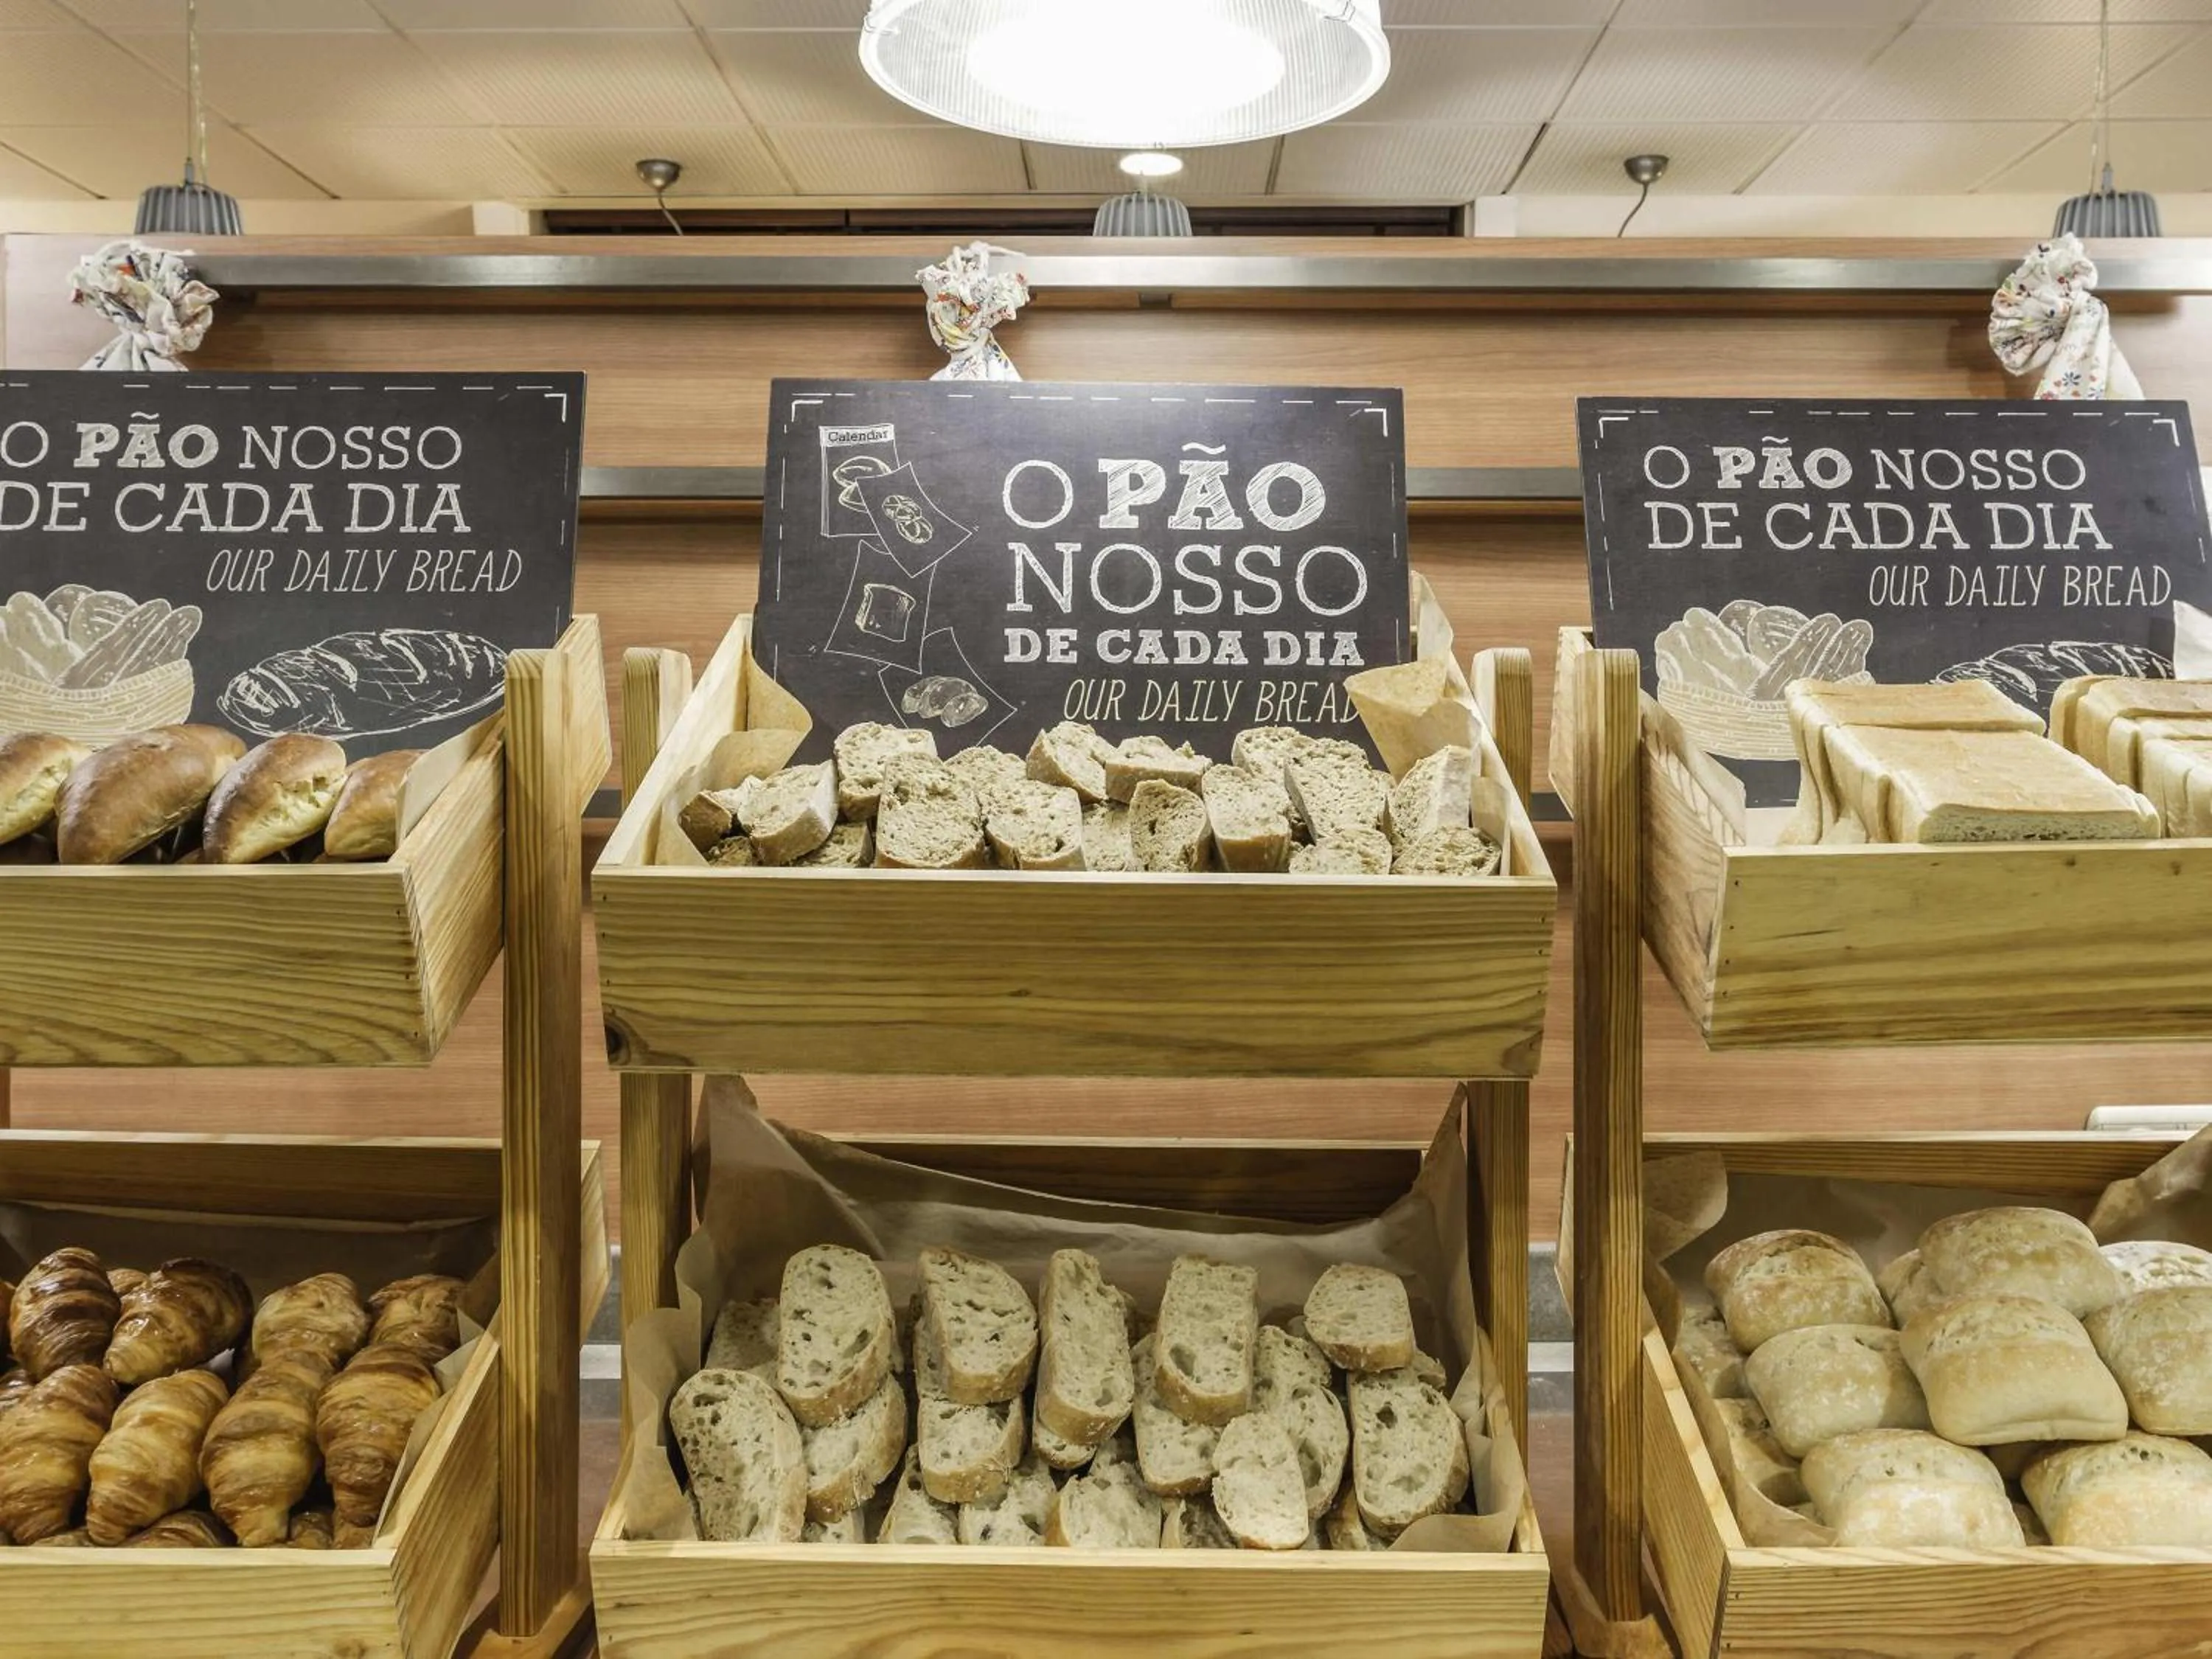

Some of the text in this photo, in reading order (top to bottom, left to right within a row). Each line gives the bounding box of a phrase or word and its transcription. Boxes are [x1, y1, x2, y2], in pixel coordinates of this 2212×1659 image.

[1, 411, 462, 470] O PÃO NOSSO
[827, 430, 888, 442] Calendar
[1001, 442, 1326, 532] O PÃO
[1644, 436, 2087, 490] O PÃO NOSSO
[0, 480, 472, 533] DE CADA DIA
[1644, 501, 2114, 551] DE CADA DIA
[206, 548, 522, 593] OUR DAILY BREAD
[1006, 541, 1368, 616] NOSSO
[1869, 564, 2172, 607] OUR DAILY BREAD
[1004, 627, 1365, 667] DE CADA DIA
[1063, 678, 1126, 721] OUR
[1137, 679, 1244, 722] DAILY
